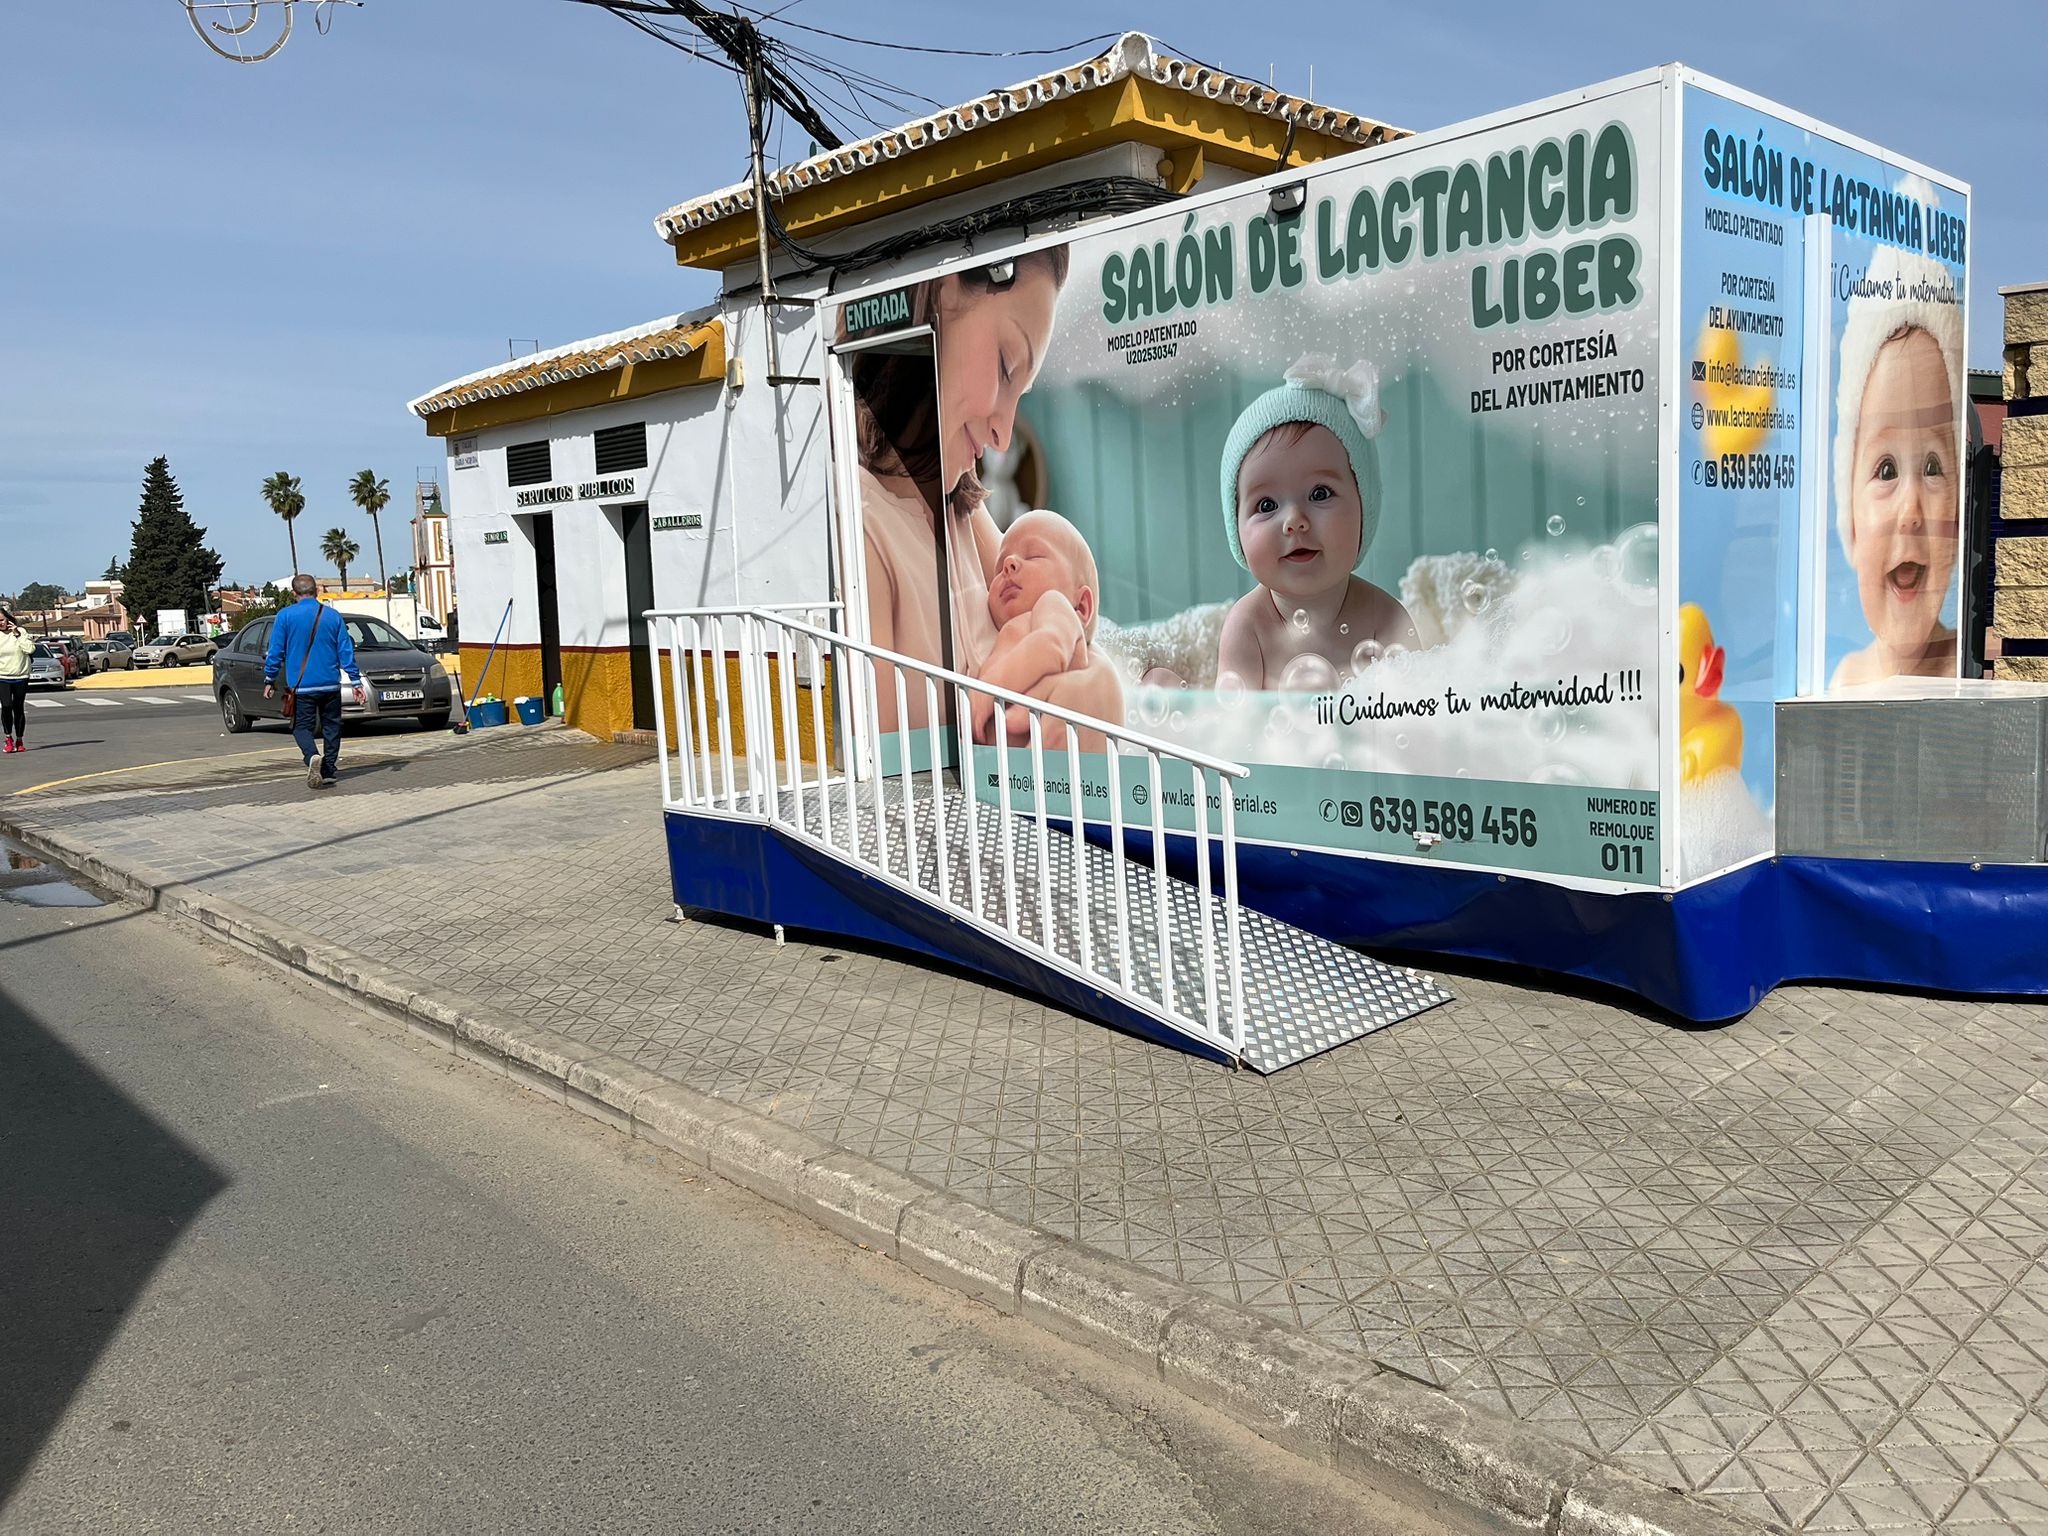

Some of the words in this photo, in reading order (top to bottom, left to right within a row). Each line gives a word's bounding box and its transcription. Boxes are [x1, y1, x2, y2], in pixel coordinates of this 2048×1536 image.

[1704, 128, 1783, 207] SALÓN
[1790, 156, 1814, 215] DE
[1820, 168, 1922, 250] LACTANCIA
[1926, 207, 1966, 265] LIBER
[1101, 212, 1234, 325] SALÓN
[1248, 211, 1304, 295] DE
[1316, 124, 1633, 280] LACTANCIA
[1704, 206, 1738, 236] MODELO
[1740, 215, 1783, 247] PATENTADO
[1471, 237, 1637, 329] LIBER
[1721, 272, 1738, 296] POR
[1738, 276, 1775, 303] CORTESÍA
[1839, 263, 1893, 302] Cuidamos
[1895, 270, 1907, 301] tu
[1909, 273, 1956, 306] maternidad
[845, 290, 910, 334] ENTRADA
[1709, 306, 1725, 330] DEL
[1725, 308, 1784, 338] AYUNTAMIENTO
[1107, 331, 1142, 353] MODELO
[1143, 319, 1197, 345] PATENTADO
[1492, 348, 1526, 375] POR
[1529, 328, 1618, 369] CORTESÍA
[1126, 342, 1178, 365] U202530347
[1471, 388, 1502, 413] DEL
[1505, 368, 1644, 409] AYUNTAMIENTO
[1708, 359, 1796, 390] info@lactanciaferial.es
[1706, 404, 1795, 430] www.lactanciaferial.es
[1721, 453, 1746, 490] 639
[1748, 453, 1771, 490] 589
[1773, 454, 1795, 489] 456
[517, 485, 573, 506] SERVICIOS
[579, 477, 634, 498] PUBLICOS
[652, 515, 701, 529] CABALLEROS
[385, 691, 404, 700] 8145
[1339, 692, 1439, 726] Cuidamos
[1445, 686, 1471, 715] tu
[1480, 672, 1614, 712] maternidad
[1369, 795, 1417, 836] 639
[1423, 800, 1474, 842] 589
[1481, 805, 1538, 848] 456
[1587, 796, 1638, 816] NUMERO
[1639, 800, 1657, 817] DE
[1589, 820, 1655, 841] REMOLQUE
[1600, 842, 1644, 874] 011
